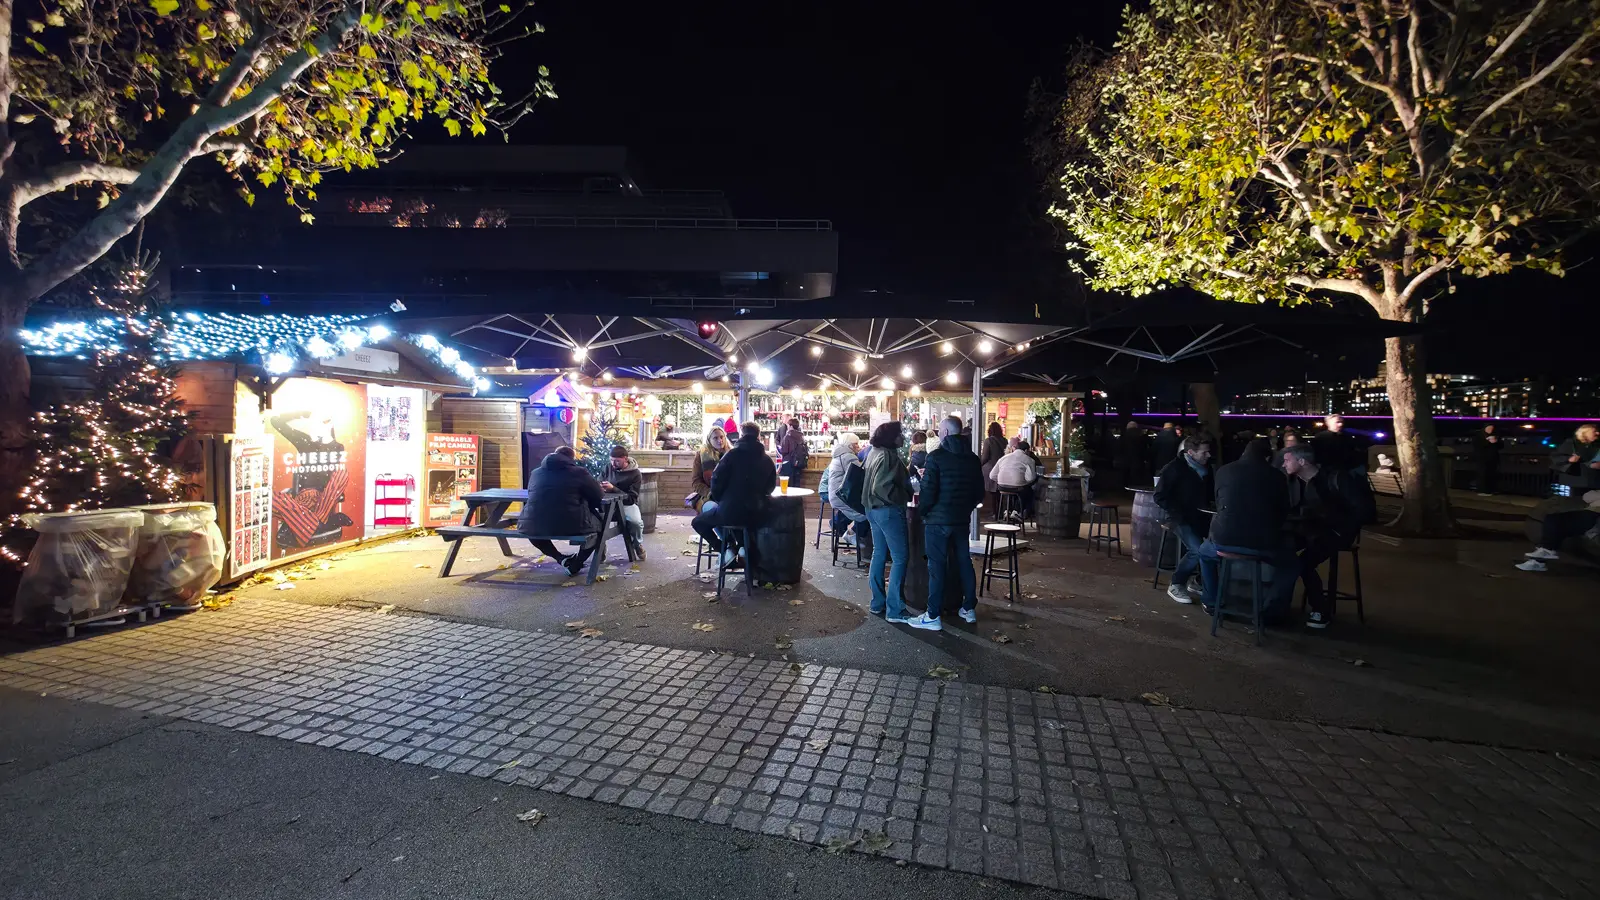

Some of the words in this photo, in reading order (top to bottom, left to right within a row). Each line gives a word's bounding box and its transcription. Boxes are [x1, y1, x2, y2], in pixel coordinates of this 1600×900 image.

[429, 441, 446, 449] FILM
[283, 450, 348, 466] CHEEEZ
[285, 463, 346, 475] PHOTOBOOTH
